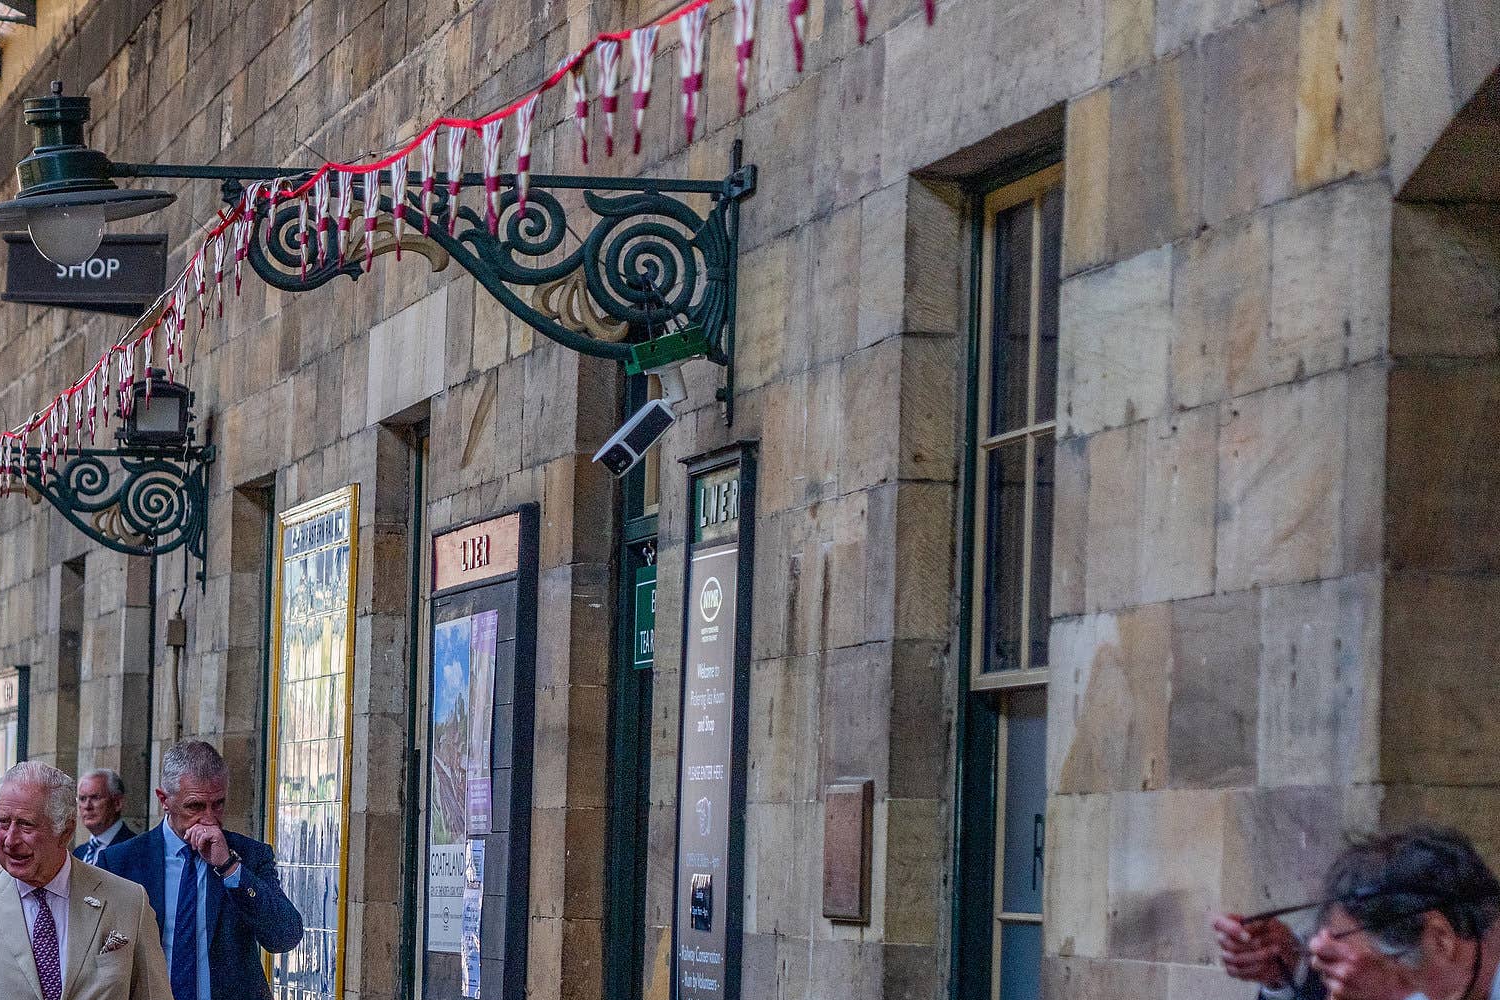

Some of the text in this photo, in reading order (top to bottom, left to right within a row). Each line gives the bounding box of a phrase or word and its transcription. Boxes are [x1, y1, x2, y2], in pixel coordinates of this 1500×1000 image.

[56, 258, 120, 279] SHOP
[700, 479, 740, 528] LNER
[461, 534, 491, 572] LNER
[430, 852, 465, 877] GOATHLAND
